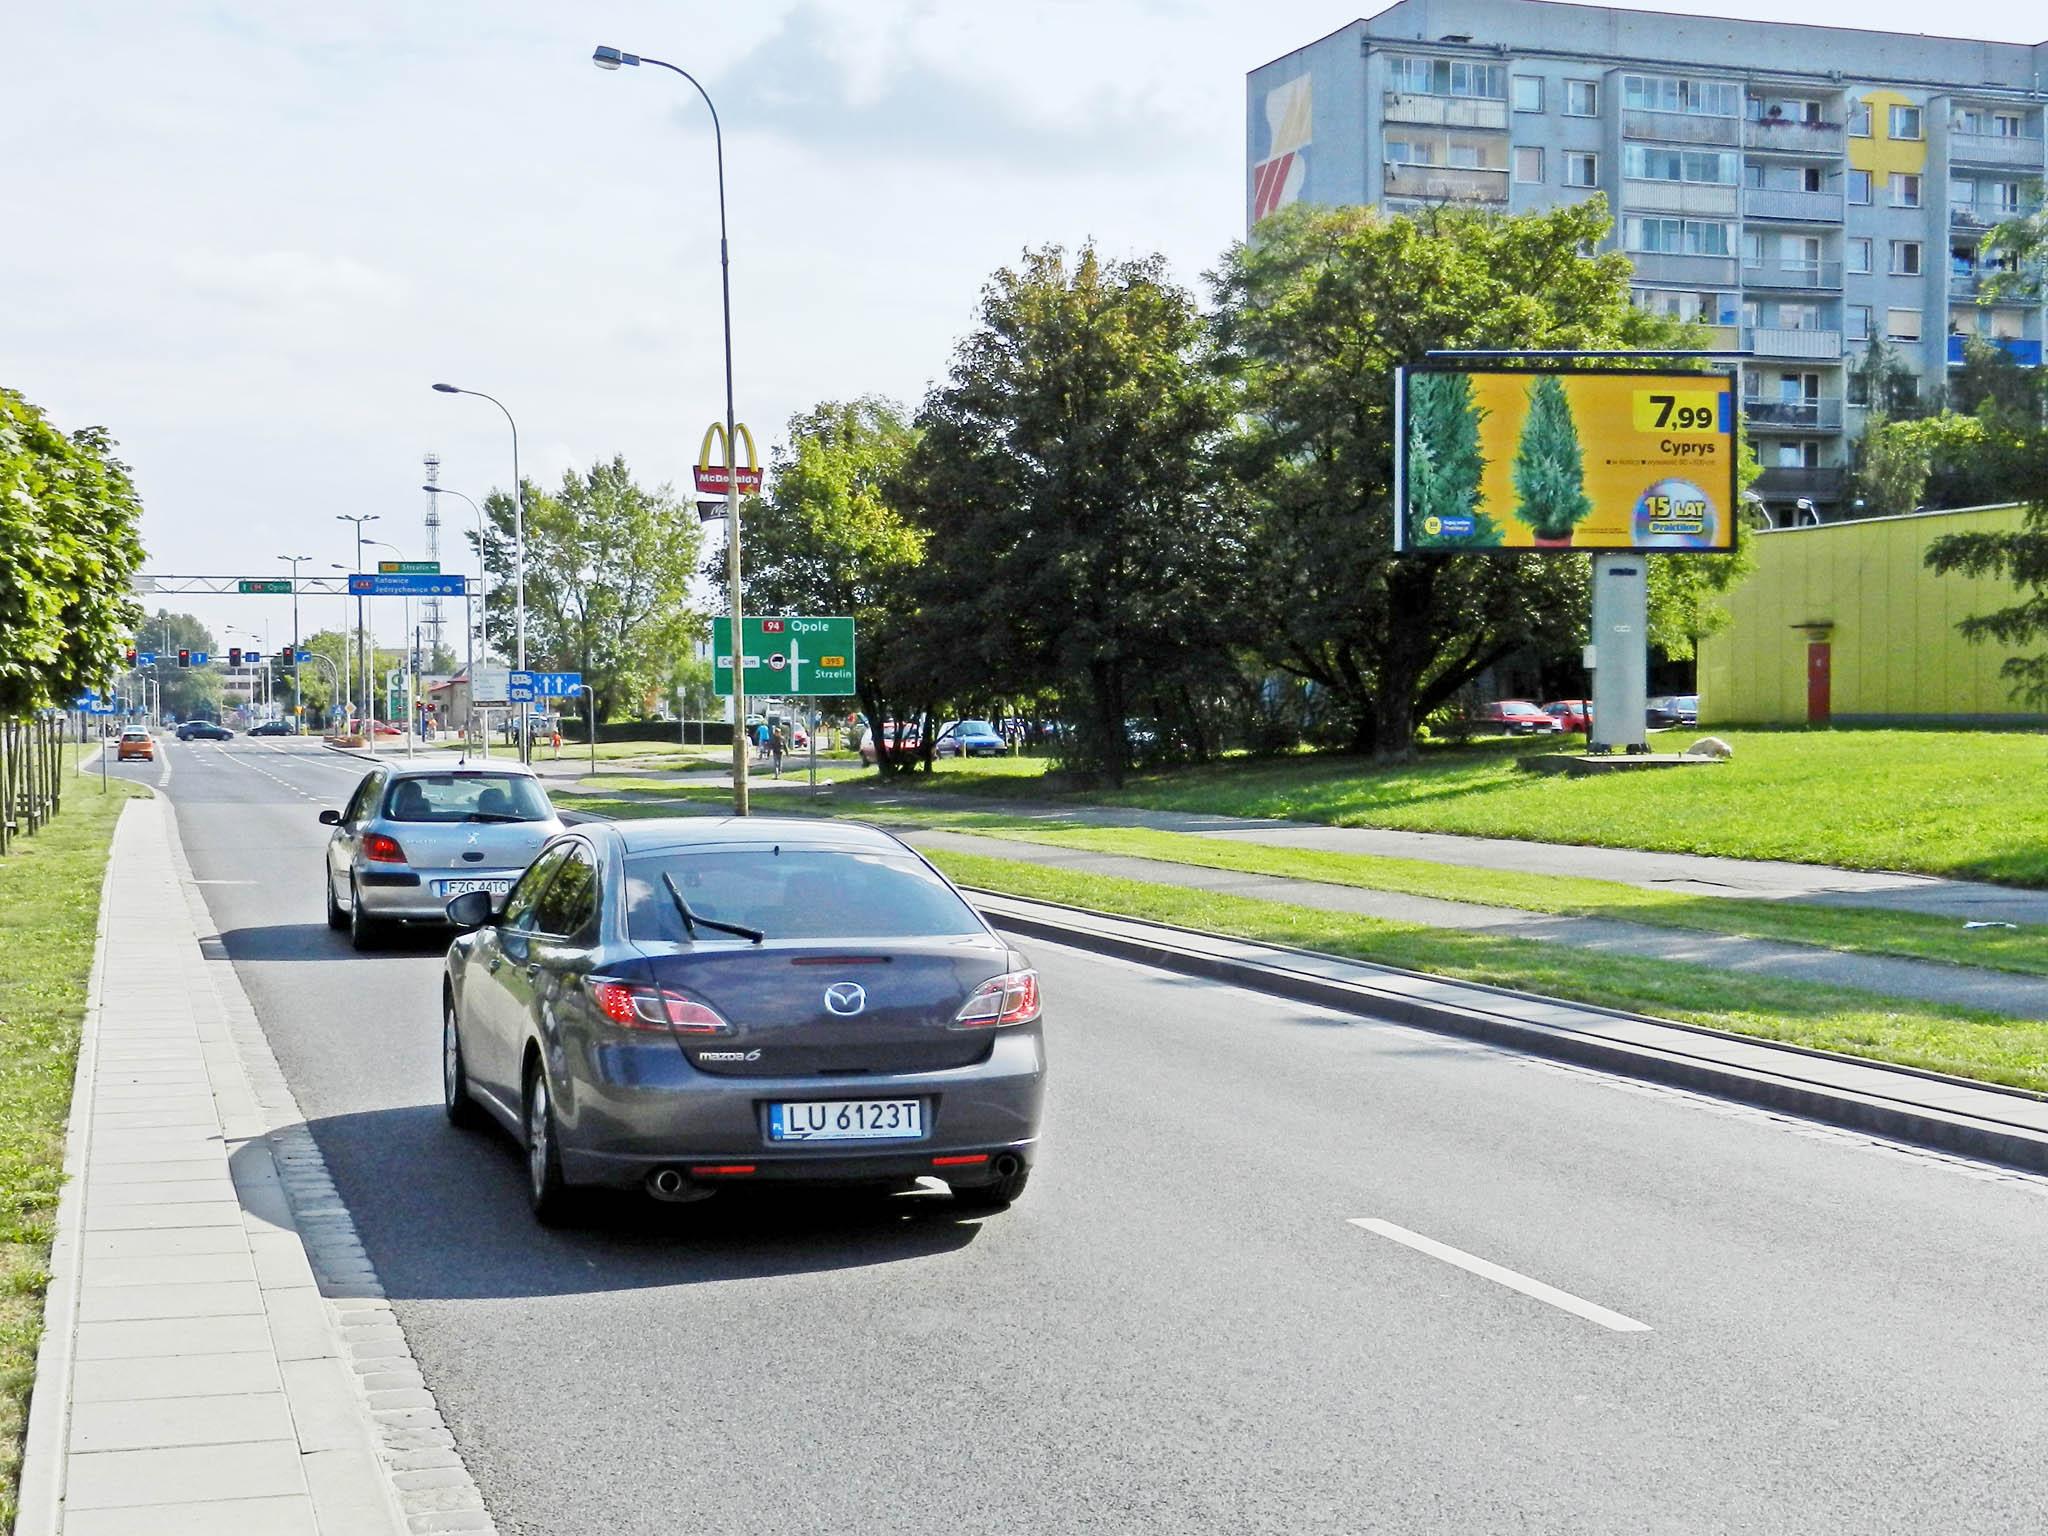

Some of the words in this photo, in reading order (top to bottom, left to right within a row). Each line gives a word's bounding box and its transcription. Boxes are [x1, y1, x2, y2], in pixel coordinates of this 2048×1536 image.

[1650, 395, 1713, 431] 7,99
[1660, 439, 1715, 456] Cyprys
[699, 474, 758, 484] McDoald's
[1644, 496, 1670, 517] 15
[1675, 501, 1705, 517] LAT
[1652, 523, 1700, 532] Praktiker
[767, 621, 780, 631] 94
[791, 620, 829, 635] Opole
[815, 670, 852, 679] Strzelin
[449, 882, 475, 894] FZG
[790, 1104, 826, 1131] LU
[837, 1103, 916, 1131] 6123T
